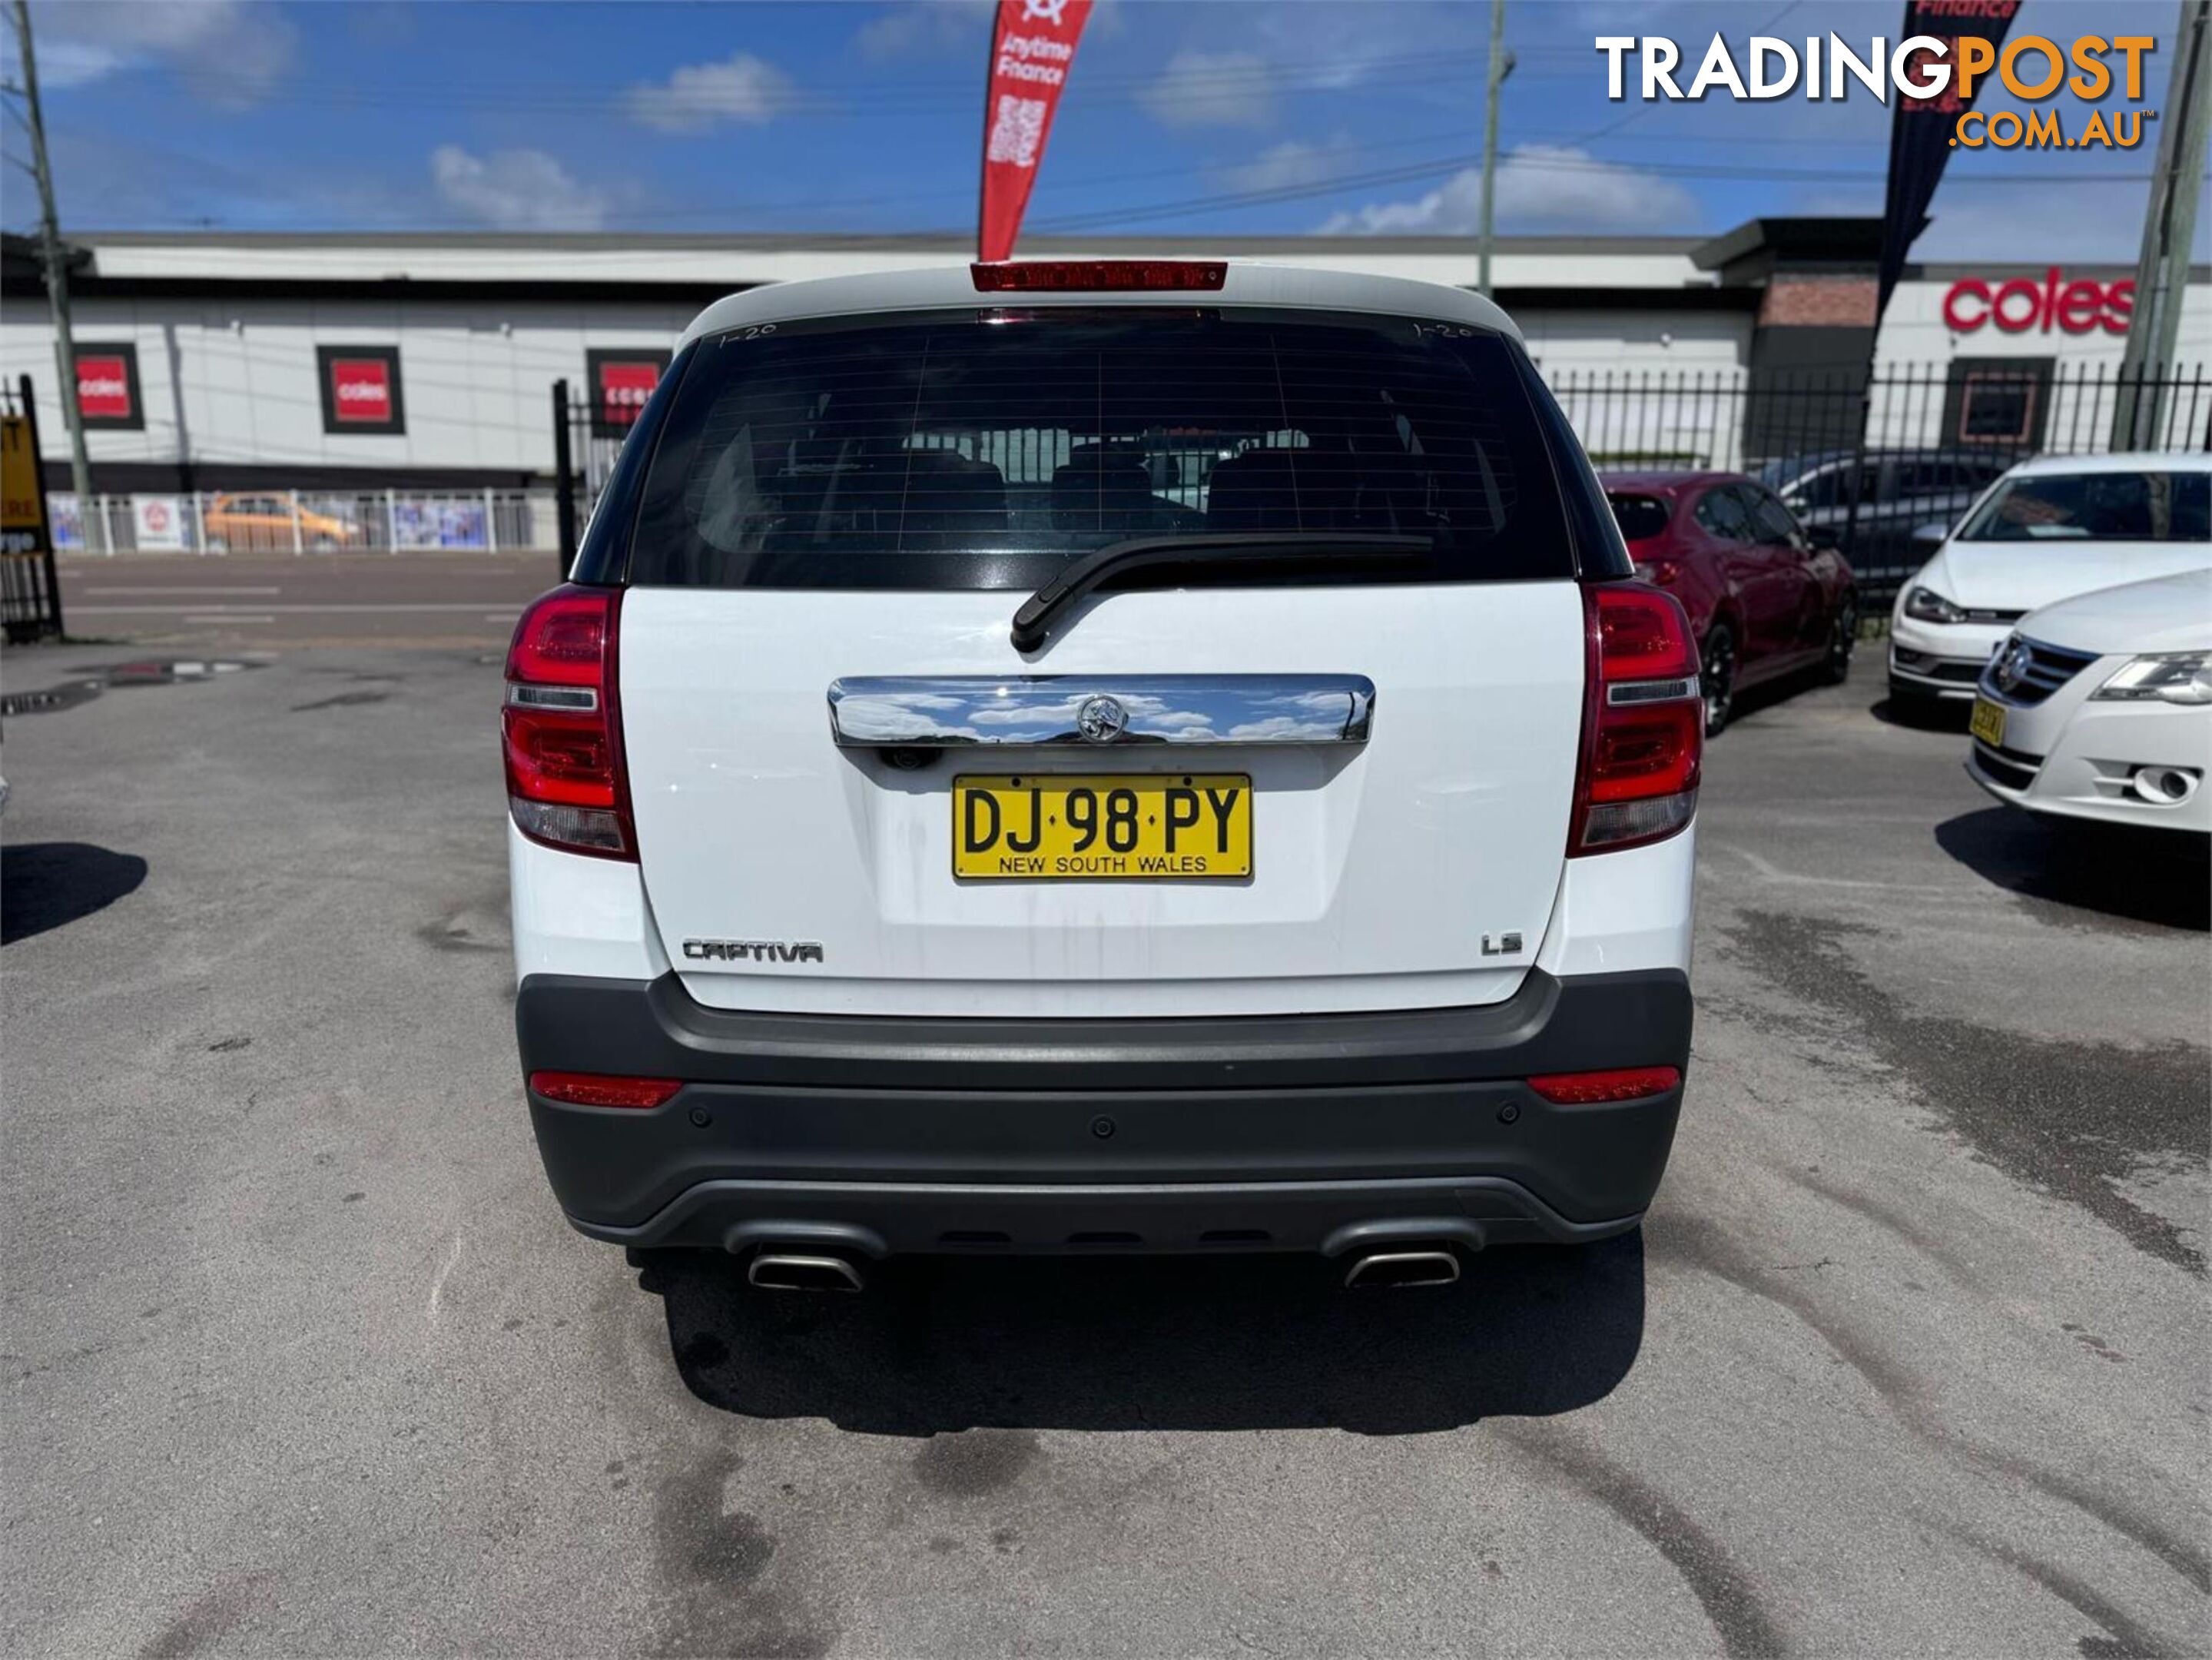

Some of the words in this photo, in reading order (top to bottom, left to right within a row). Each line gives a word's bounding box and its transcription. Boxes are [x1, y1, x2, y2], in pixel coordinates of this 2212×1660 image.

[1001, 32, 1073, 60] Anytime
[997, 56, 1063, 85] Finance
[1942, 266, 2136, 336] coles
[78, 377, 125, 397] coles
[337, 380, 386, 400] coles
[1000, 857, 1046, 873] NEW
[1056, 857, 1126, 873] SOUTH
[1138, 856, 1207, 873] WALES
[682, 938, 824, 963] CAPTIVA
